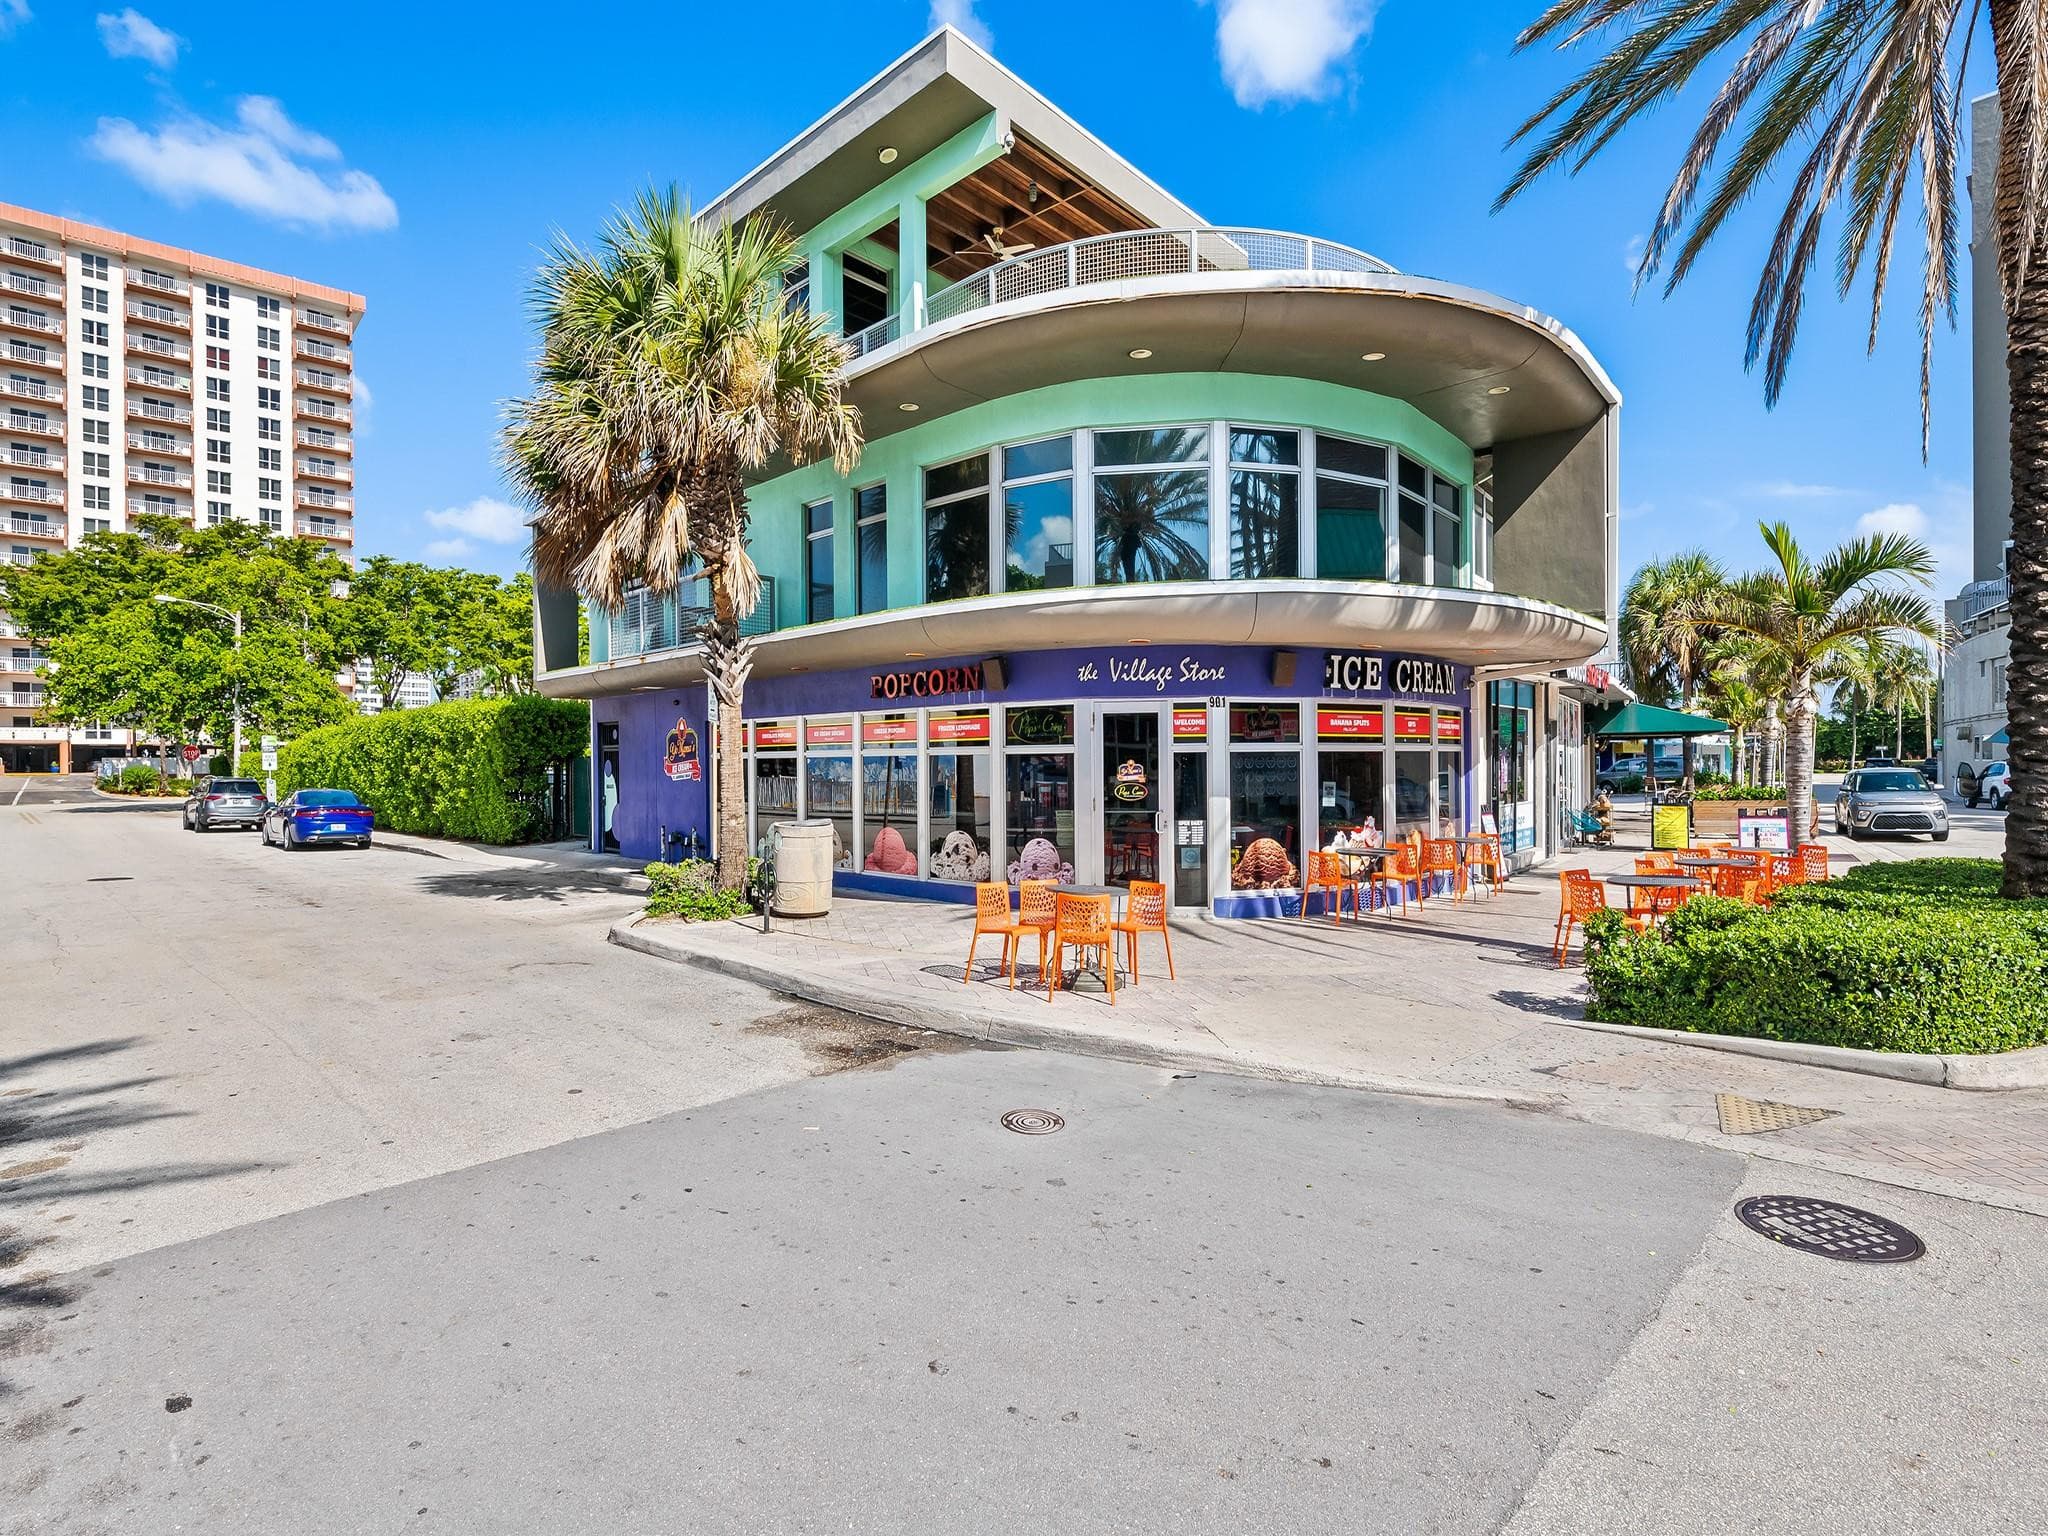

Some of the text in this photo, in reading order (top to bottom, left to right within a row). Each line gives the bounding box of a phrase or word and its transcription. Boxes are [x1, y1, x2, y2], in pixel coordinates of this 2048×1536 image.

[870, 664, 981, 699] POPCORN
[1077, 656, 1226, 692] the Village Store
[1328, 654, 1457, 695] ICE CREAM
[1209, 696, 1226, 708] 901
[1173, 718, 1206, 726] WELCOME
[183, 750, 199, 759] STOP
